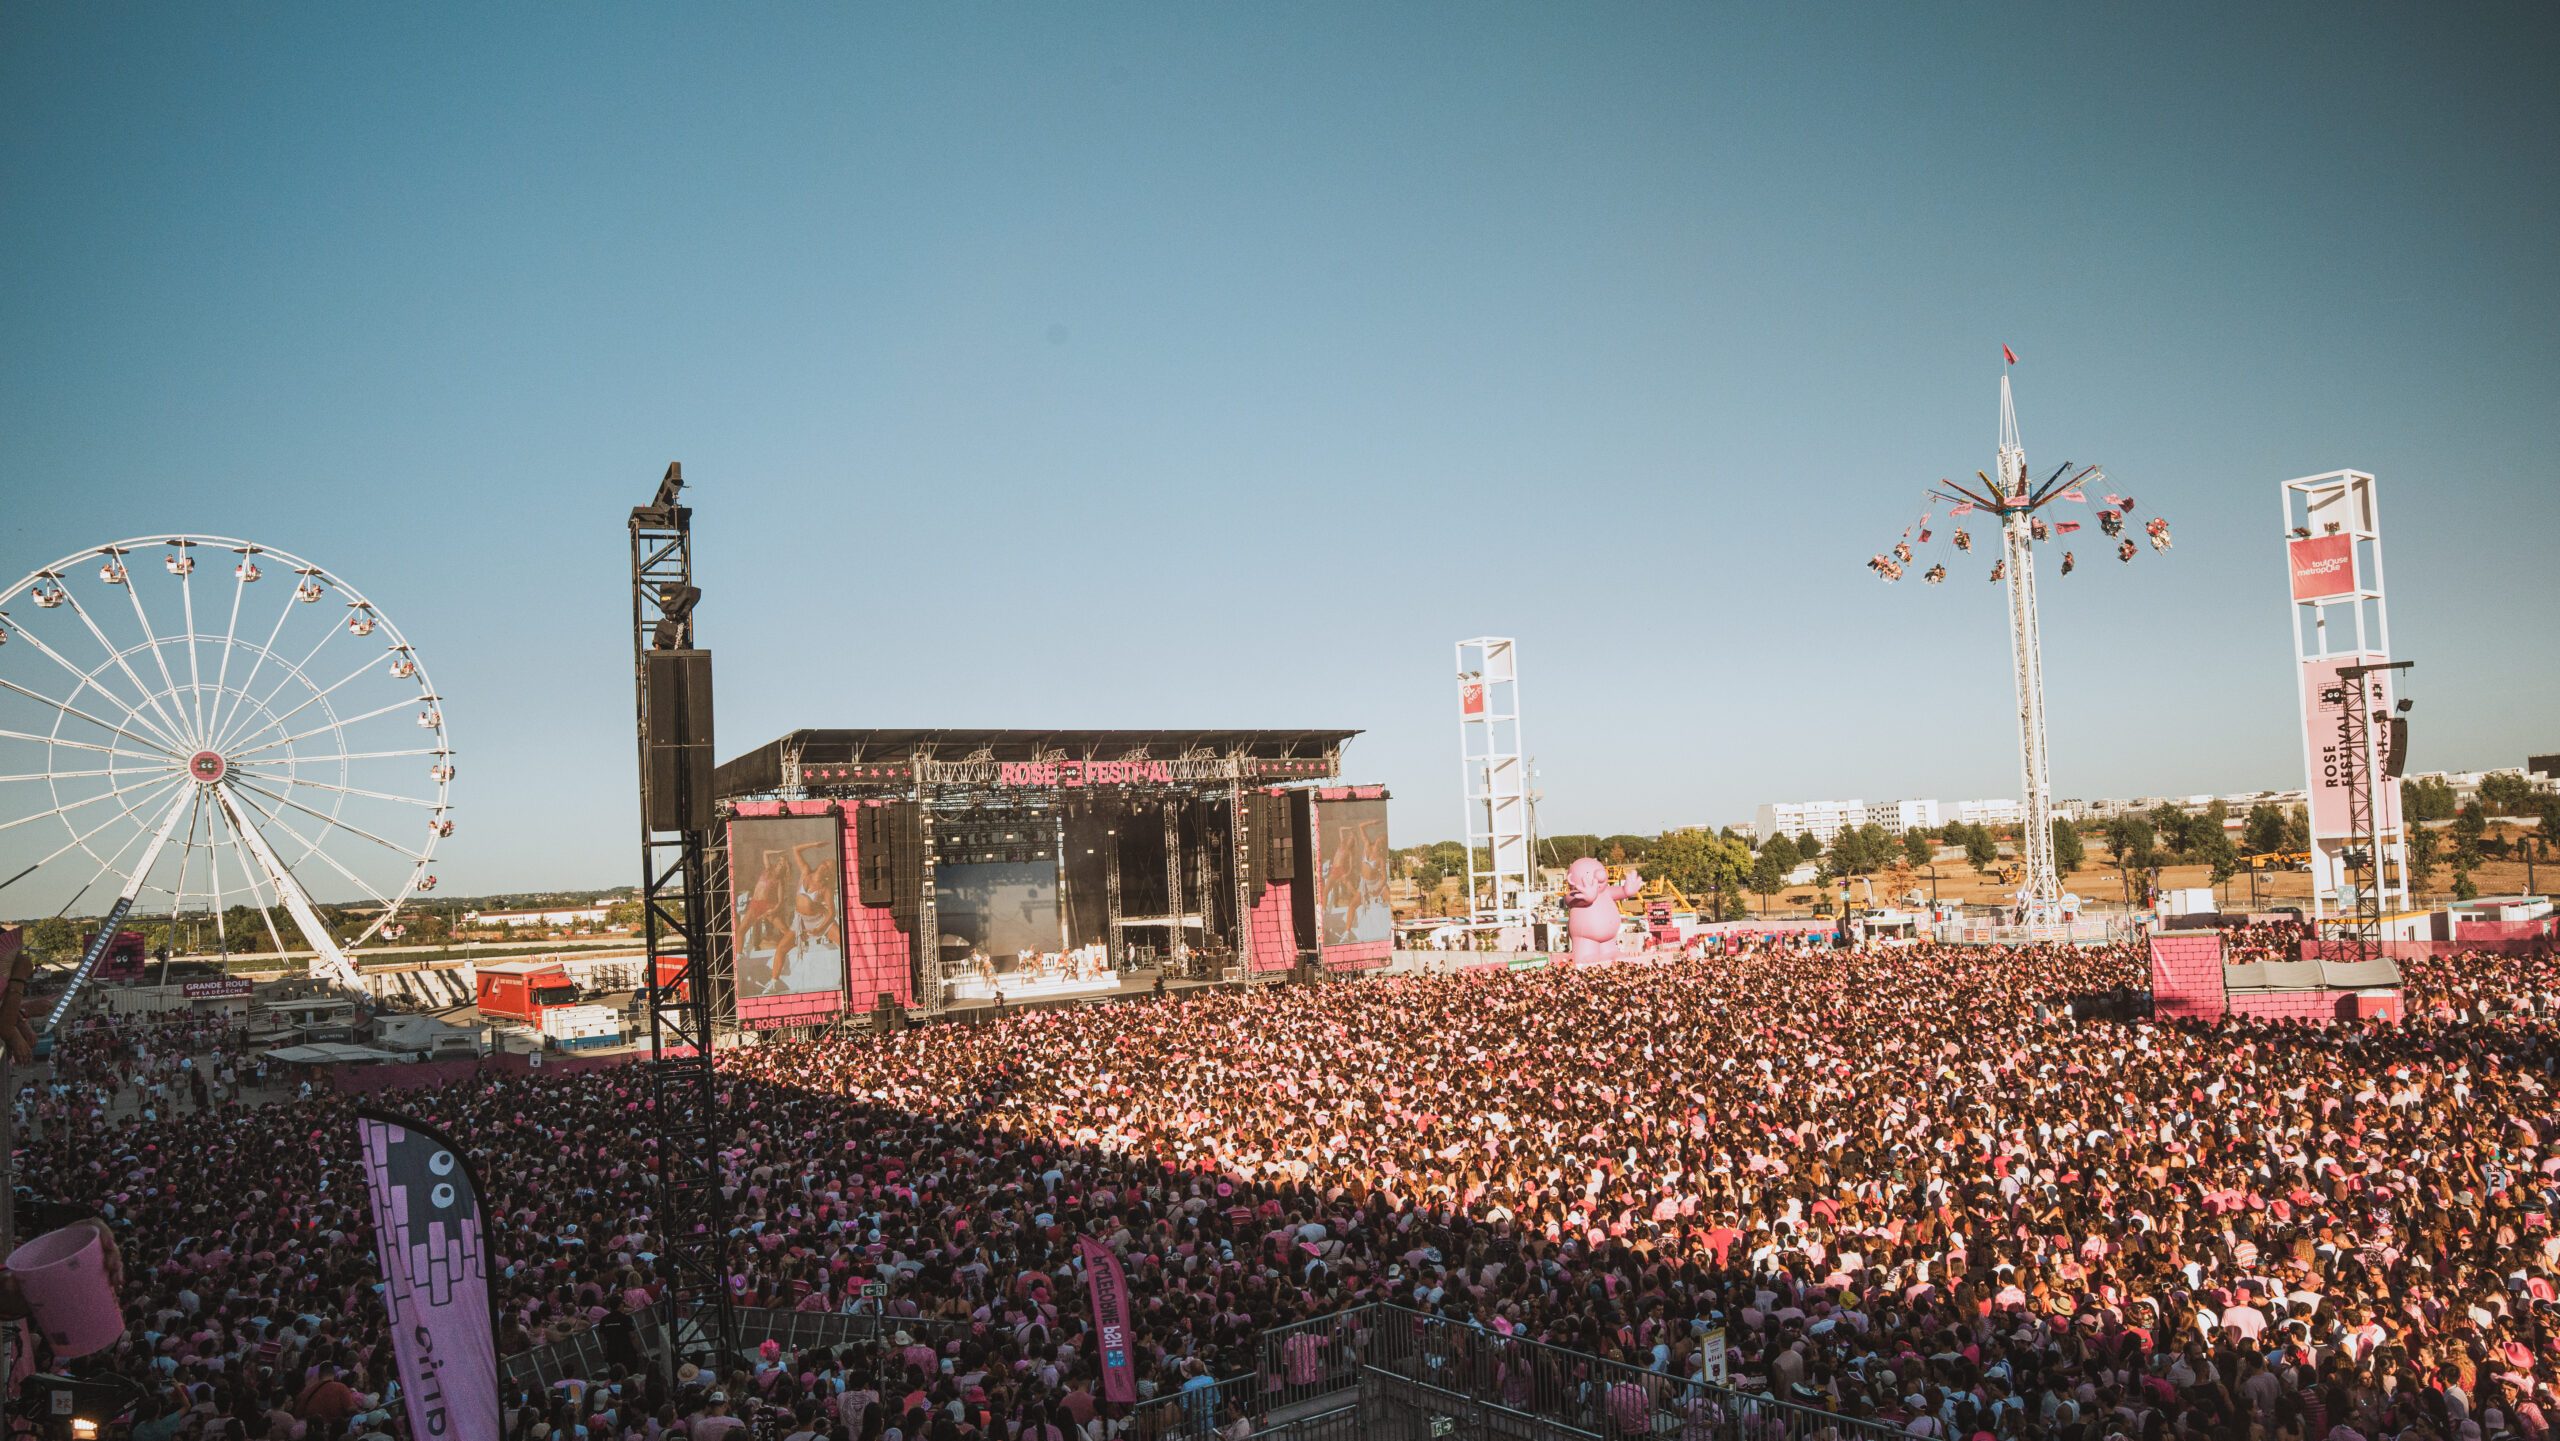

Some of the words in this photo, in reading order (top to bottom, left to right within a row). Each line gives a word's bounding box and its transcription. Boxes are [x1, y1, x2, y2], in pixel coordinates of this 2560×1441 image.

[2312, 556, 2348, 567] toulouse
[2337, 714, 2352, 787] FESTIVAL
[1001, 762, 1058, 786] ROSE
[1086, 760, 1173, 784] FESTIVAL
[2323, 746, 2338, 788] ROSE
[1333, 962, 1353, 972] ROSE
[1354, 959, 1382, 970] FESTIVAL
[186, 981, 223, 991] GRANDE
[225, 979, 250, 988] ROUE
[754, 1018, 782, 1030] ROSE
[784, 1013, 829, 1027] FESTIVAL
[2490, 1173, 2501, 1188] 2
